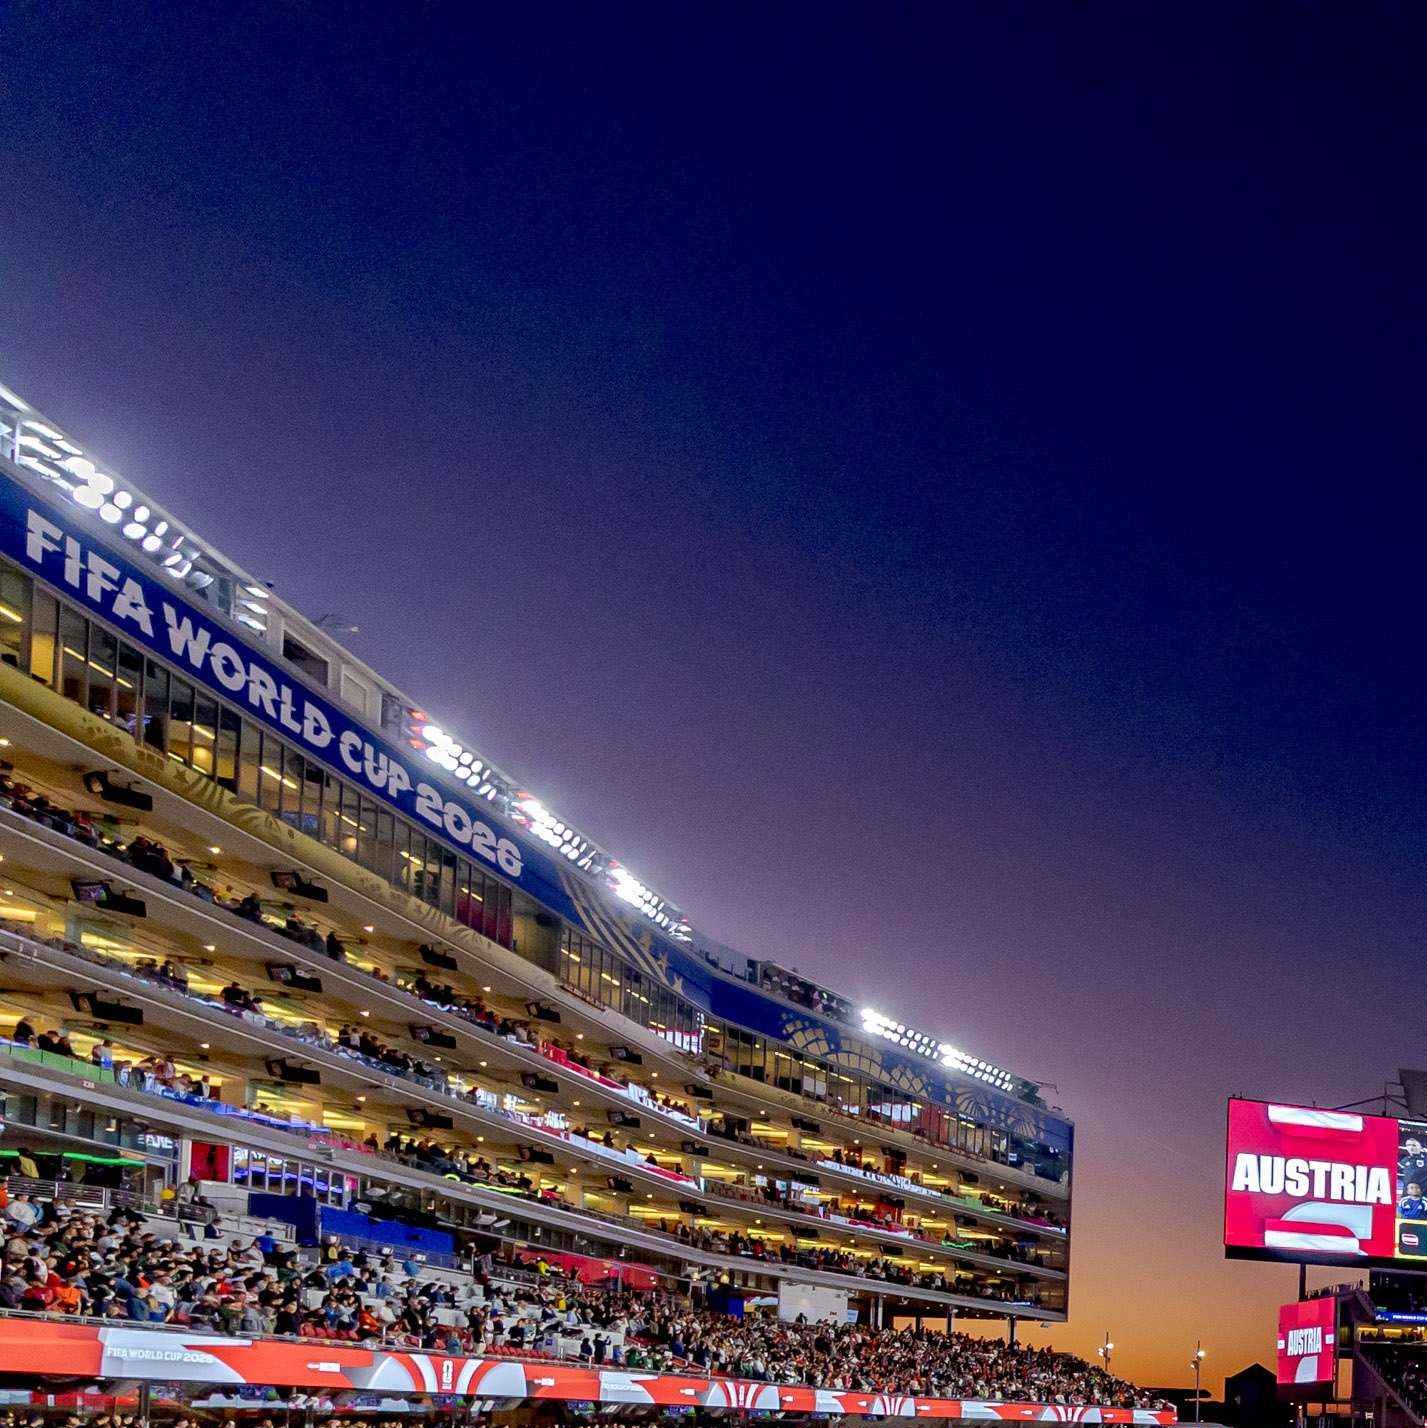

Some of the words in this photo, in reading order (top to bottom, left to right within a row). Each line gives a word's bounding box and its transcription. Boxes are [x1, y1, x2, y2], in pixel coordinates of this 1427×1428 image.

[27, 509, 155, 638] FIFA
[163, 601, 336, 748] WORLD
[340, 731, 415, 798] CUP
[414, 782, 525, 878] 2026
[1232, 1153, 1392, 1204] AUSTRIA
[130, 1349, 163, 1361] WORLD
[164, 1351, 182, 1362] CUP
[1287, 1327, 1322, 1356] AUSTRIA
